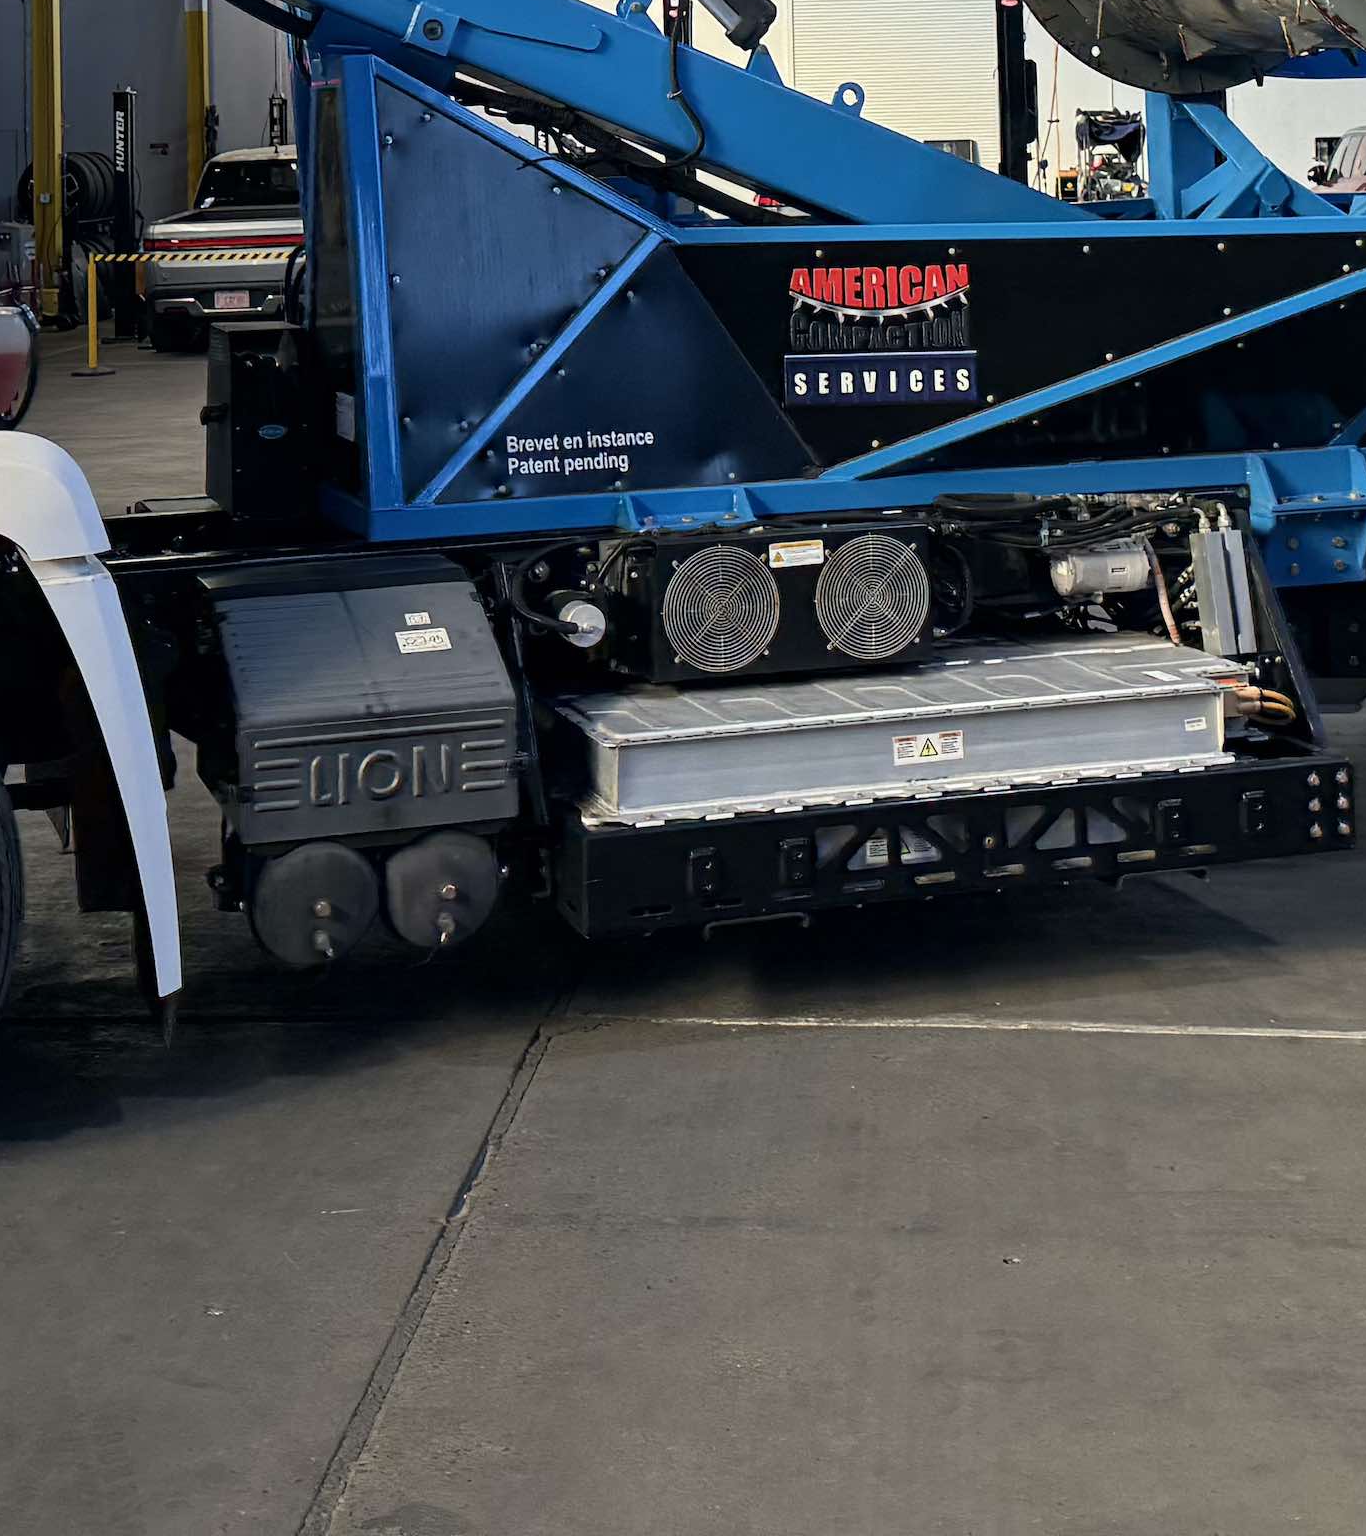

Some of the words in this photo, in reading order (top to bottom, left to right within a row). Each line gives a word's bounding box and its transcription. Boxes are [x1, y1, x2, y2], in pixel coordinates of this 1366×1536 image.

[116, 110, 125, 172] HUNTER
[789, 263, 970, 309] AMERICAN
[793, 368, 971, 396] SERVICES
[506, 433, 560, 453] Brevet
[562, 436, 583, 450] en
[586, 430, 655, 449] instance
[507, 455, 561, 476] Patent
[564, 452, 630, 476] pending
[309, 744, 452, 806] LION
